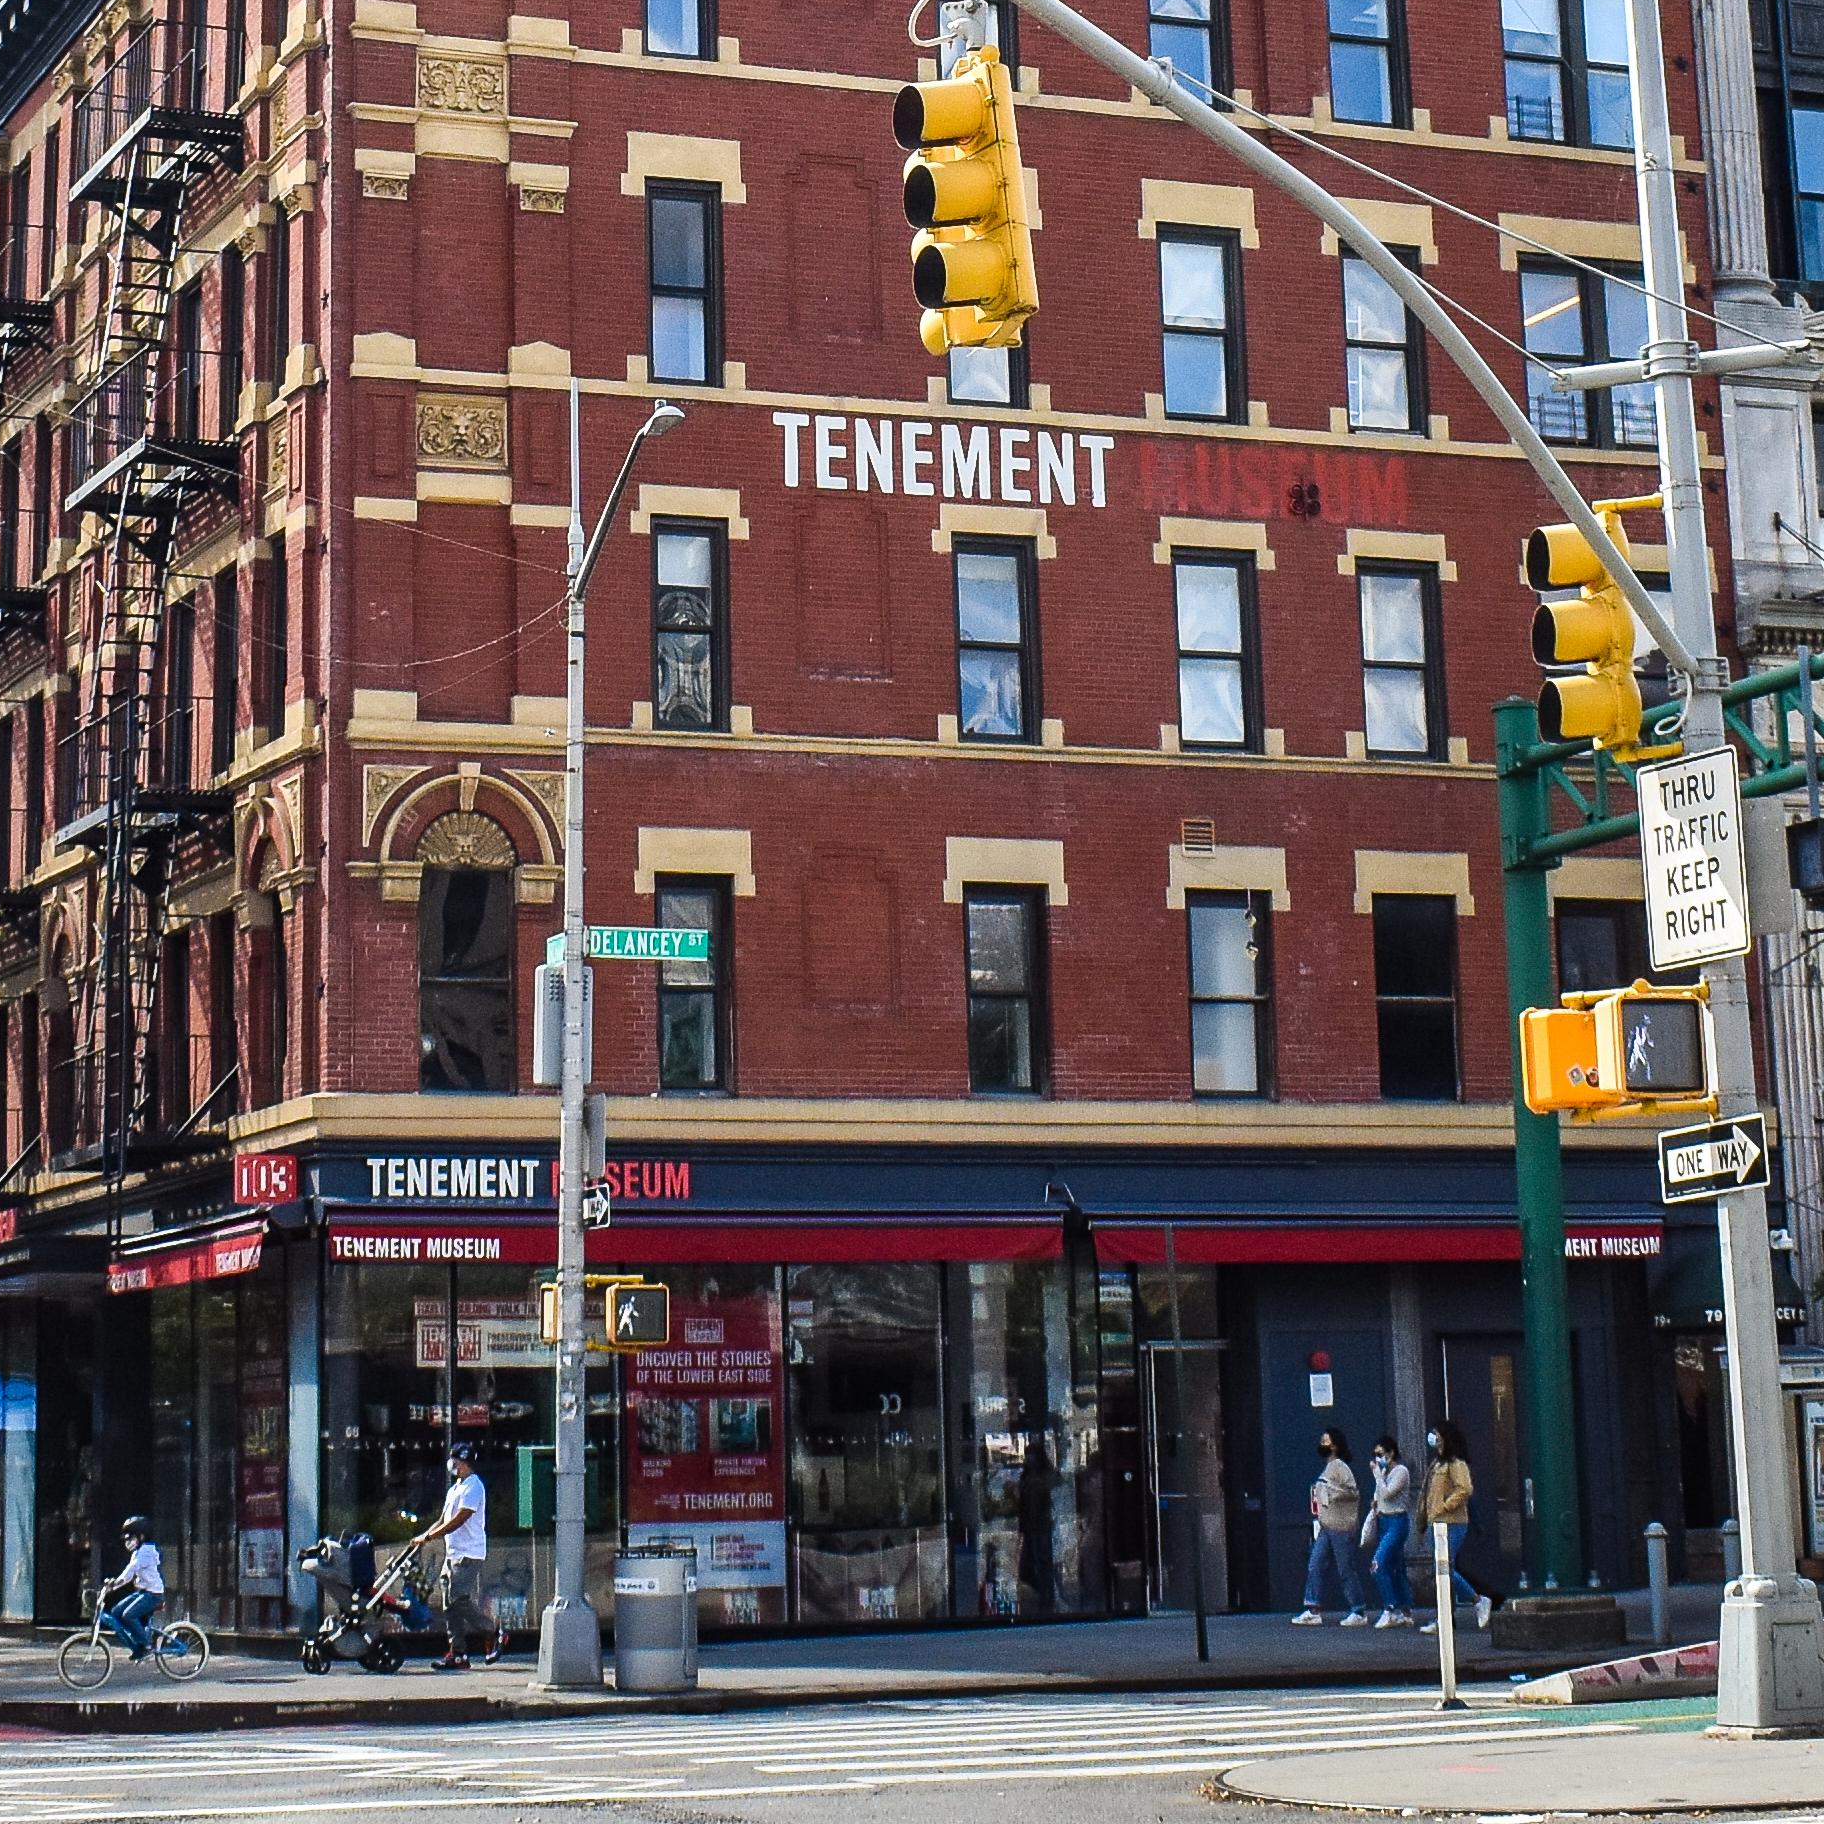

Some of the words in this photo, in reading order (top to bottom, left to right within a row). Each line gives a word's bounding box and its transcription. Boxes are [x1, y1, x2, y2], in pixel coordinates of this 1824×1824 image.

[773, 411, 1115, 508] TENEMENT
[1660, 770, 1716, 812] THRU
[1654, 810, 1730, 857] TRAFFIC
[1667, 856, 1721, 897] KEEP
[1667, 899, 1728, 940] RIGHT
[590, 930, 683, 956] DELANCEY
[688, 934, 705, 946] ST
[1676, 1148, 1705, 1176] ONE
[1717, 1141, 1747, 1170] WAY
[366, 1158, 540, 1198] TENEMENT
[333, 1236, 422, 1259] TENEMENT
[426, 1237, 501, 1259] MUSEUM
[1601, 1236, 1661, 1256] MUSEUM
[1705, 1309, 1723, 1323] 79
[636, 1352, 692, 1367] UNCOVER
[695, 1352, 718, 1367] THE
[721, 1351, 772, 1366] STORIES
[636, 1370, 650, 1383] OF
[653, 1370, 674, 1384] THE
[677, 1370, 715, 1384] LOWER
[718, 1370, 743, 1383] EAST
[747, 1369, 772, 1383] SIDE
[684, 1492, 773, 1510] TENEMENT.ORG
